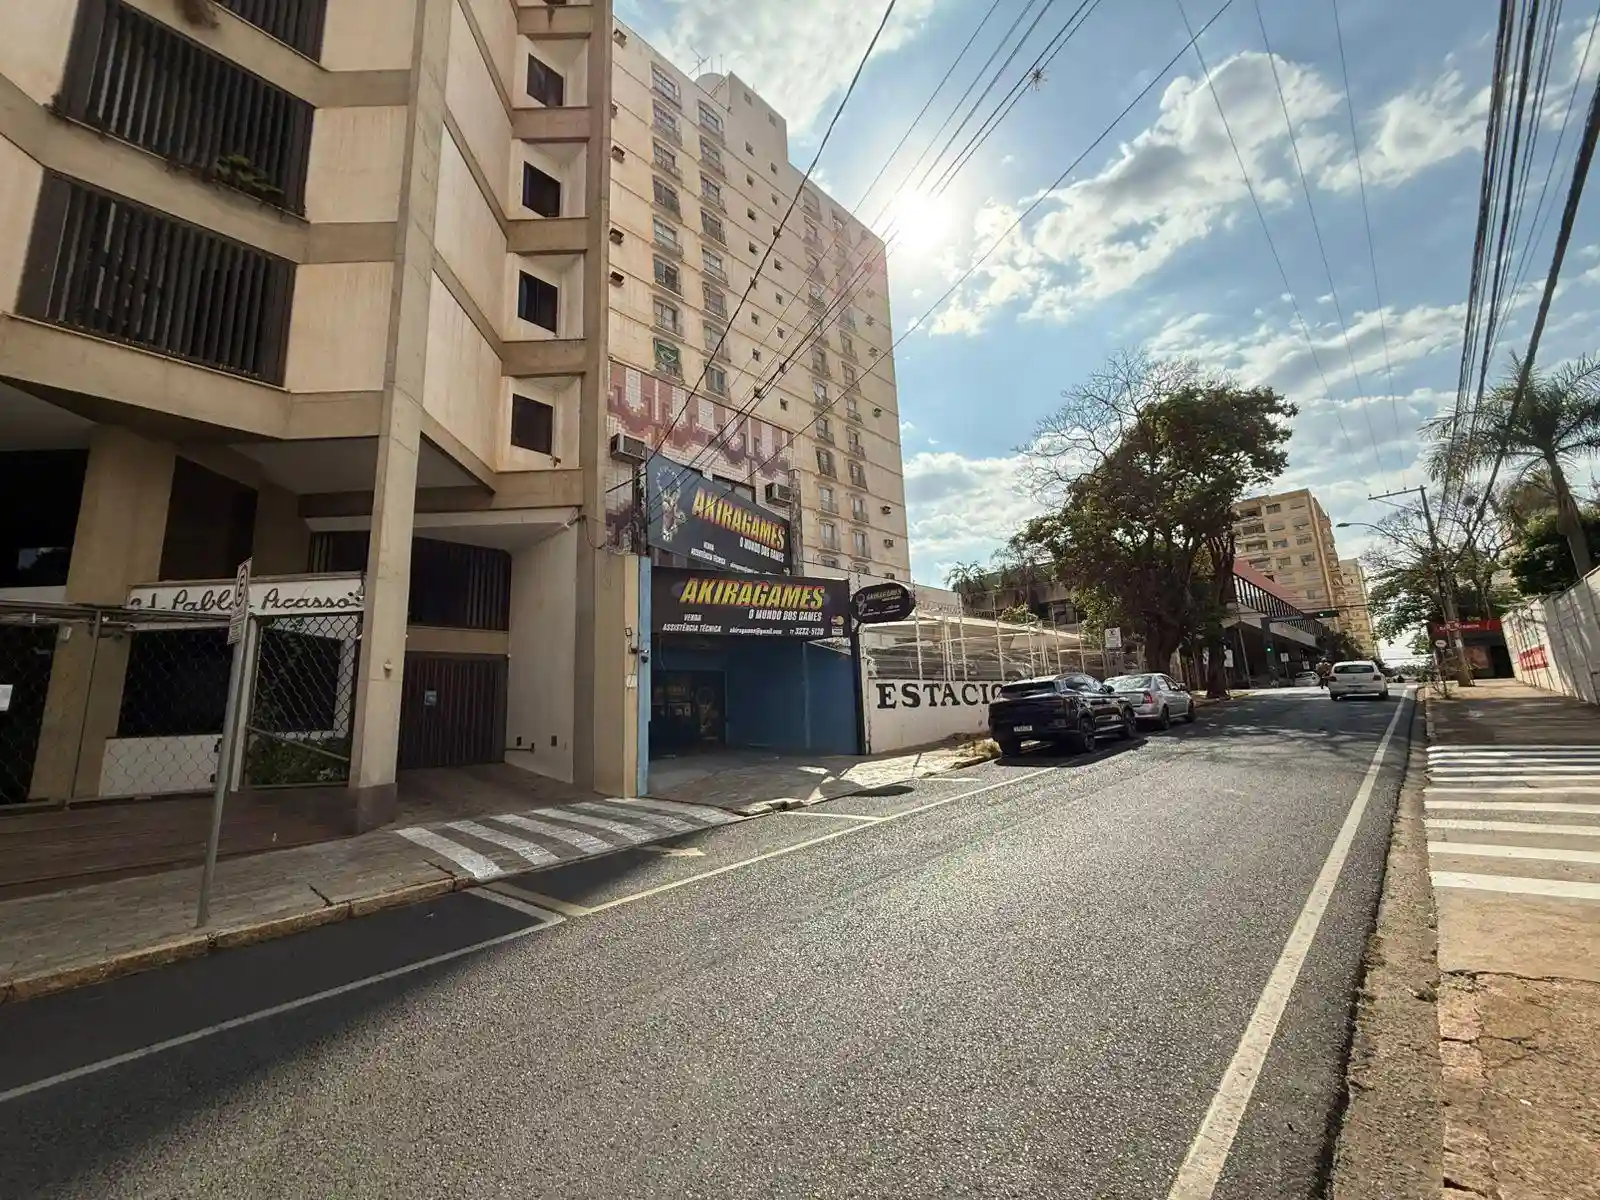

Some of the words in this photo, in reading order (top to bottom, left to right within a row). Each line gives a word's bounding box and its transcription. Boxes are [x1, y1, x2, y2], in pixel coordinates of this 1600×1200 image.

[692, 487, 786, 550] AKIRAGAMES
[171, 589, 236, 611] Pabl
[261, 588, 354, 610] Picasso
[679, 578, 826, 610] AKIRAGAMES
[748, 609, 754, 619] O
[755, 609, 782, 620] MUNDO
[782, 610, 797, 621] DOS
[798, 611, 823, 622] GAMES
